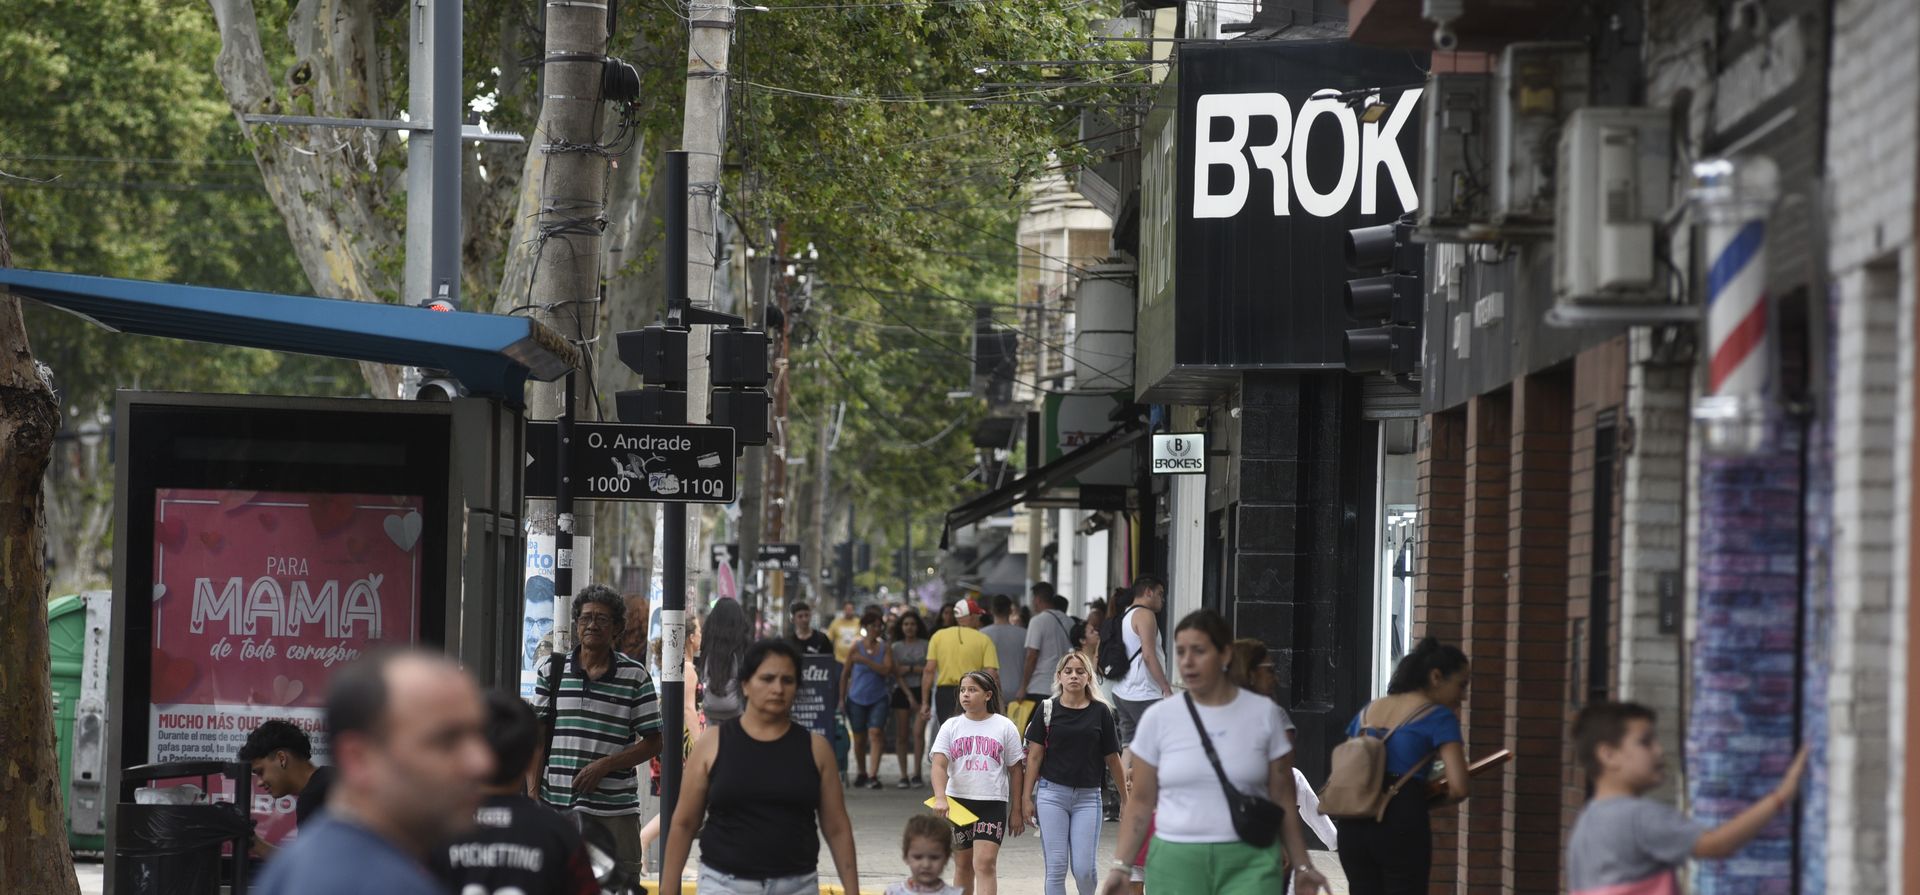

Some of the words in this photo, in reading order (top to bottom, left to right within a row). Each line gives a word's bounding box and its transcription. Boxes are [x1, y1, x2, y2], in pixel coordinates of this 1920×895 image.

[1193, 88, 1424, 218] BROK
[588, 432, 608, 448] O.
[613, 433, 691, 450] Andrade
[1175, 438, 1183, 451] B
[1155, 458, 1203, 469] BROKERS
[587, 476, 631, 493] 1000
[267, 556, 309, 576] PARA
[210, 636, 232, 661] de
[240, 637, 277, 662] todo
[286, 640, 361, 668] corazón
[158, 714, 204, 729] MUCHO
[207, 712, 234, 730] MÁS
[238, 716, 262, 732] QUE
[158, 730, 189, 741] Durante
[191, 731, 199, 741] el
[200, 733, 217, 742] mes
[218, 731, 229, 742] de
[157, 742, 179, 753] gafas
[182, 744, 200, 754] para
[216, 743, 225, 752] te
[949, 736, 975, 762] NEW
[157, 754, 167, 763] La
